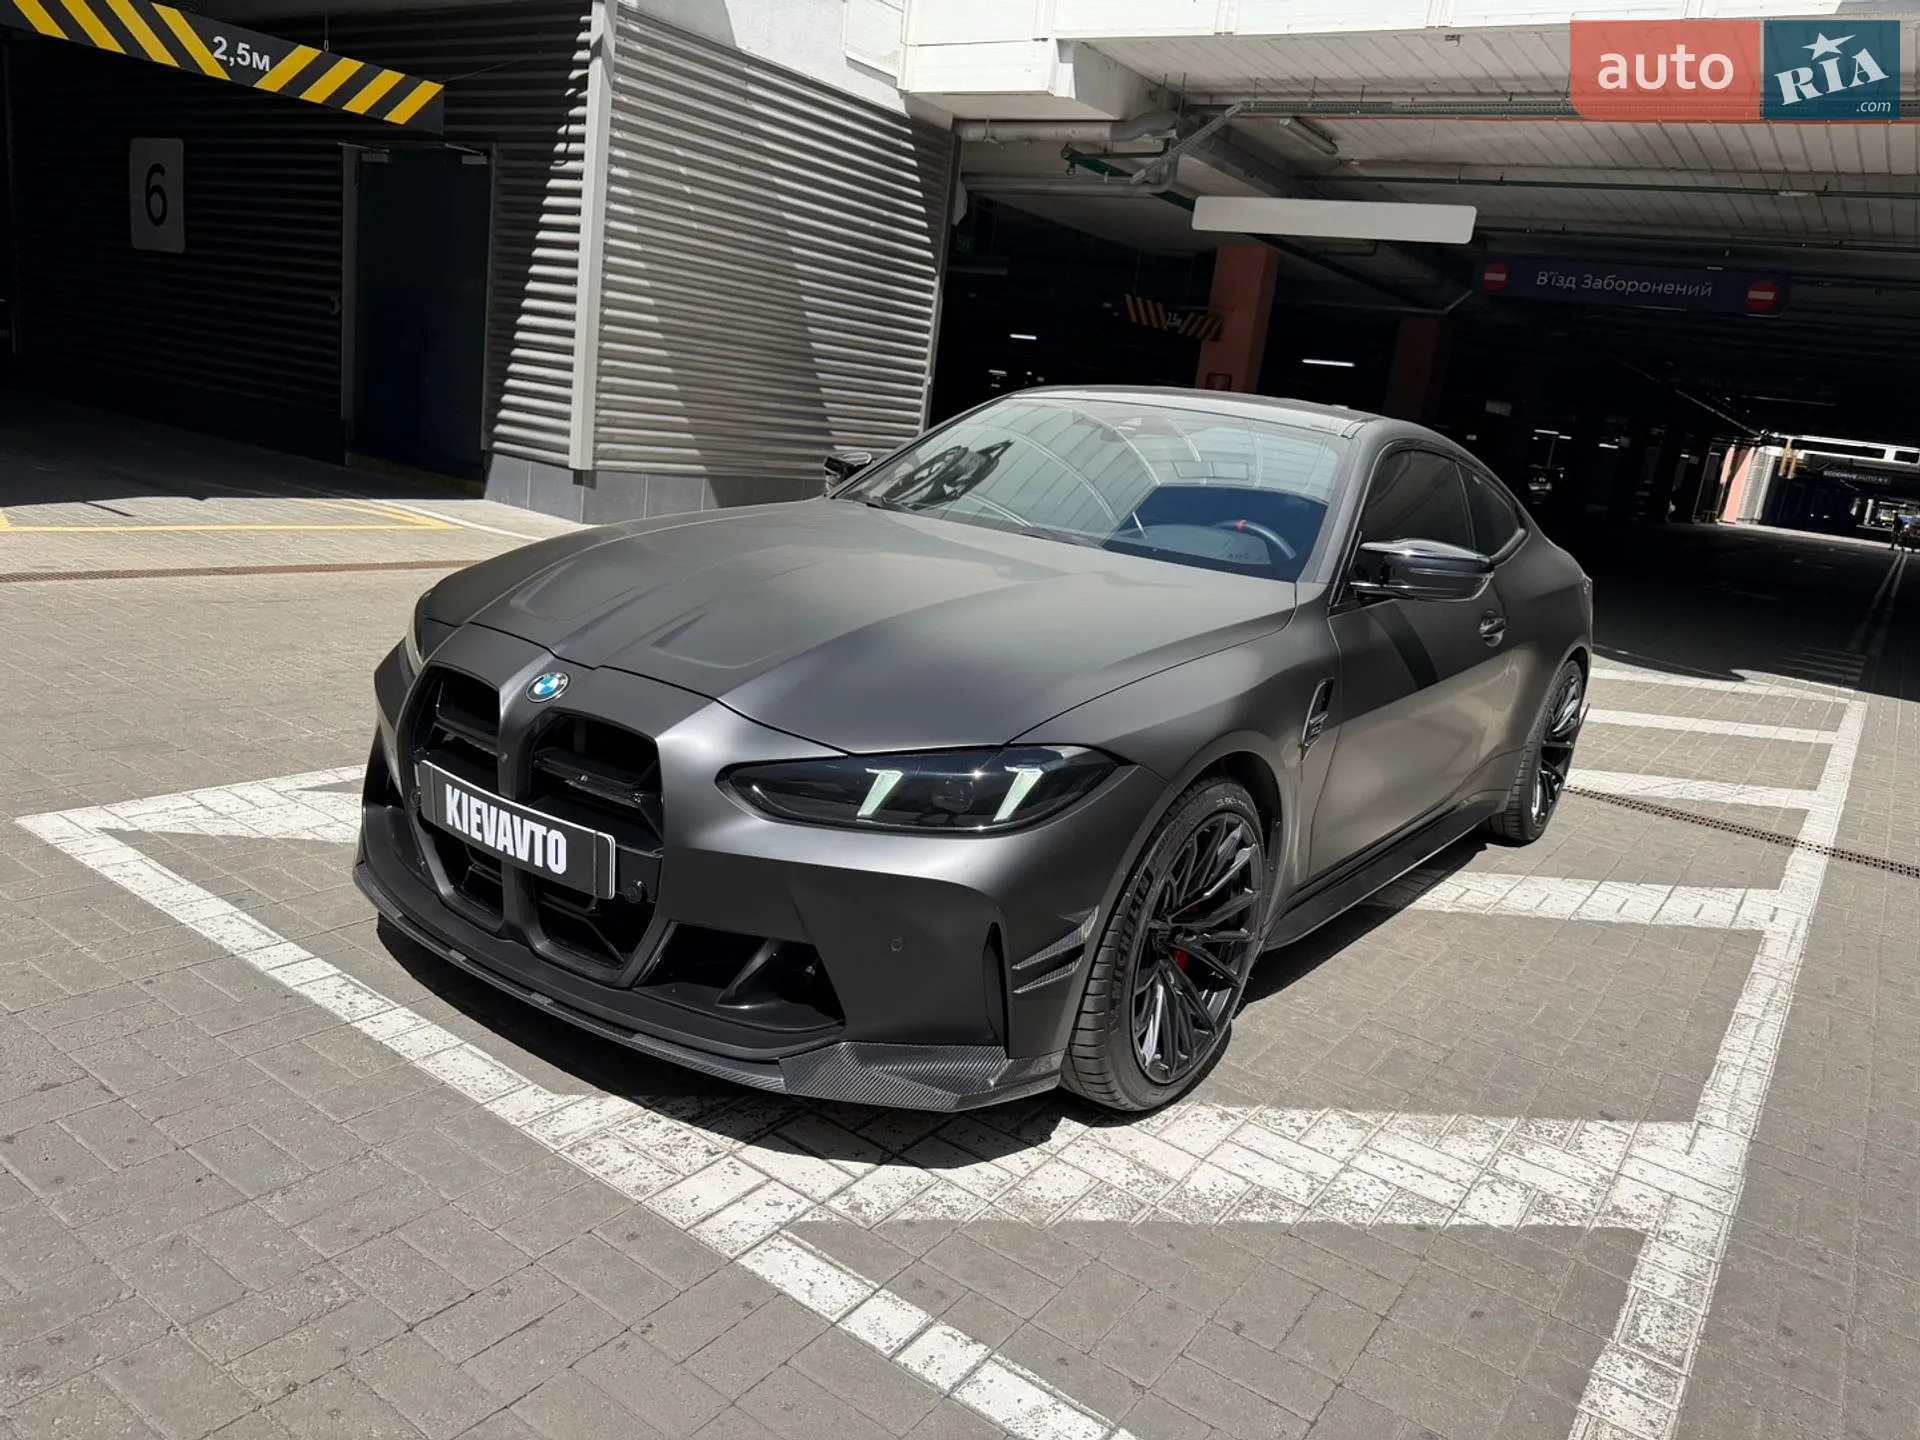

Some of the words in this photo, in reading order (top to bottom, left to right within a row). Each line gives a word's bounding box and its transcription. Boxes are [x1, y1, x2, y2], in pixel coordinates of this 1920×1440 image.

[144, 162, 168, 227] 6
[1581, 273, 1714, 297] Заборонений
[445, 783, 567, 875] KIEVAVTO
[1111, 866, 1154, 1001] MICHELIN
